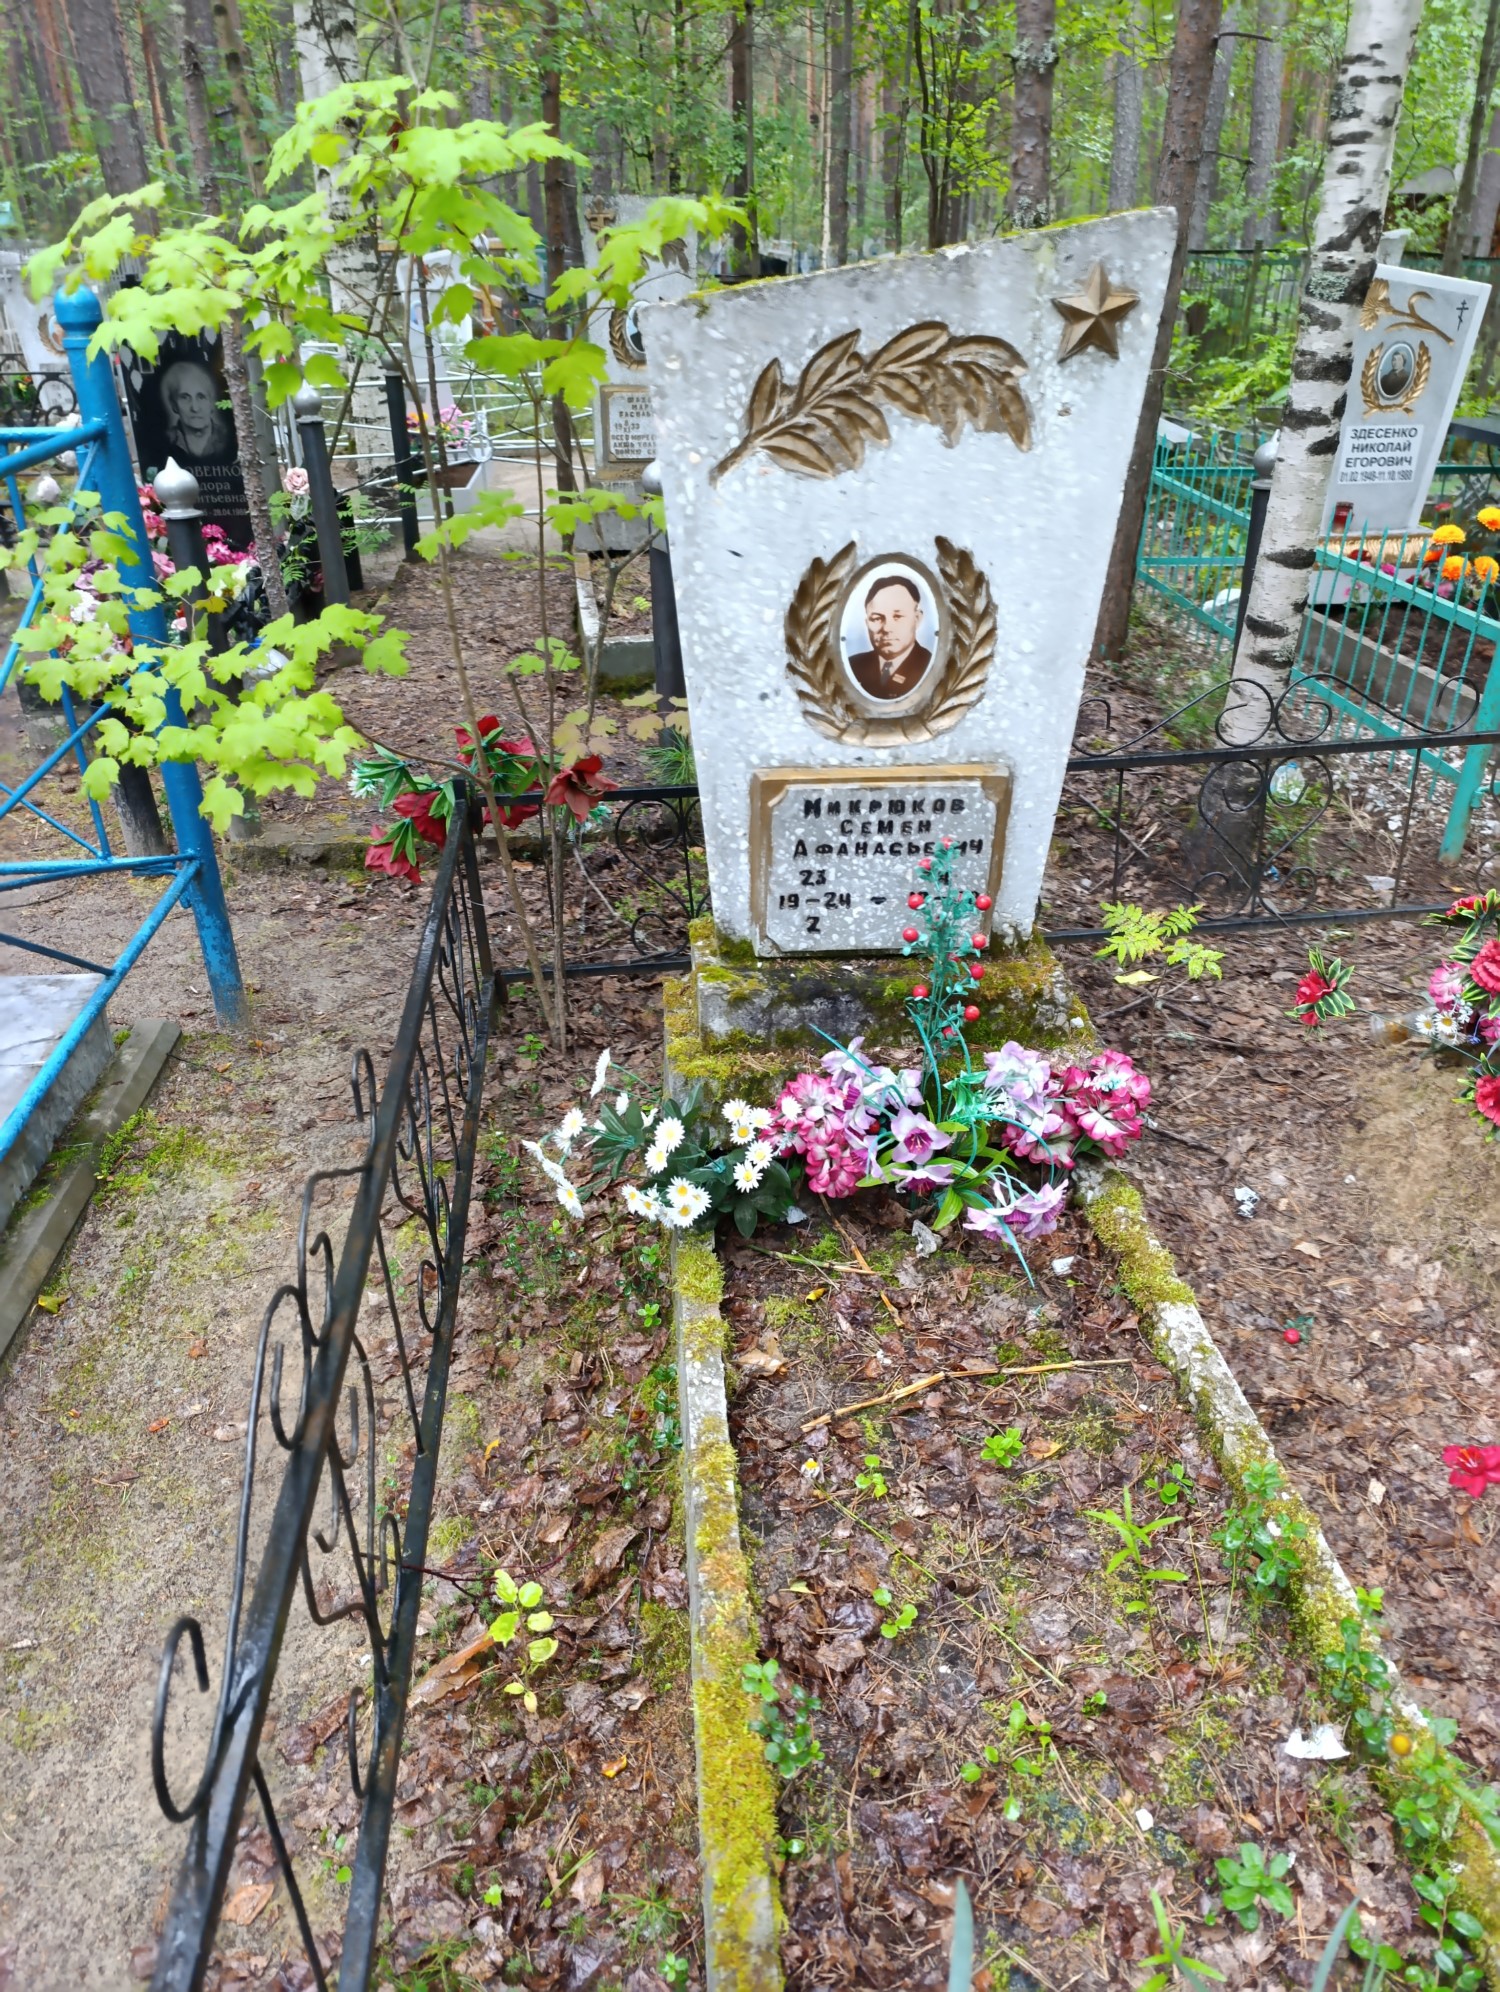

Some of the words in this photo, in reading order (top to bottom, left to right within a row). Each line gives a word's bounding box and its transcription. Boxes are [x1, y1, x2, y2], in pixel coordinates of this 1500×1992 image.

[1350, 427, 1418, 440] ЗДЕСЕНКО
[1351, 440, 1412, 453] НИКОЛАЙ
[1345, 456, 1412, 468] ЕГОРОВИЧ
[185, 465, 242, 477] ОВЕНКО
[199, 481, 231, 493] дора
[840, 819, 932, 836] СЕМЕН
[793, 838, 984, 859] АФАНАСЬЕИЧ
[799, 869, 827, 886] 23
